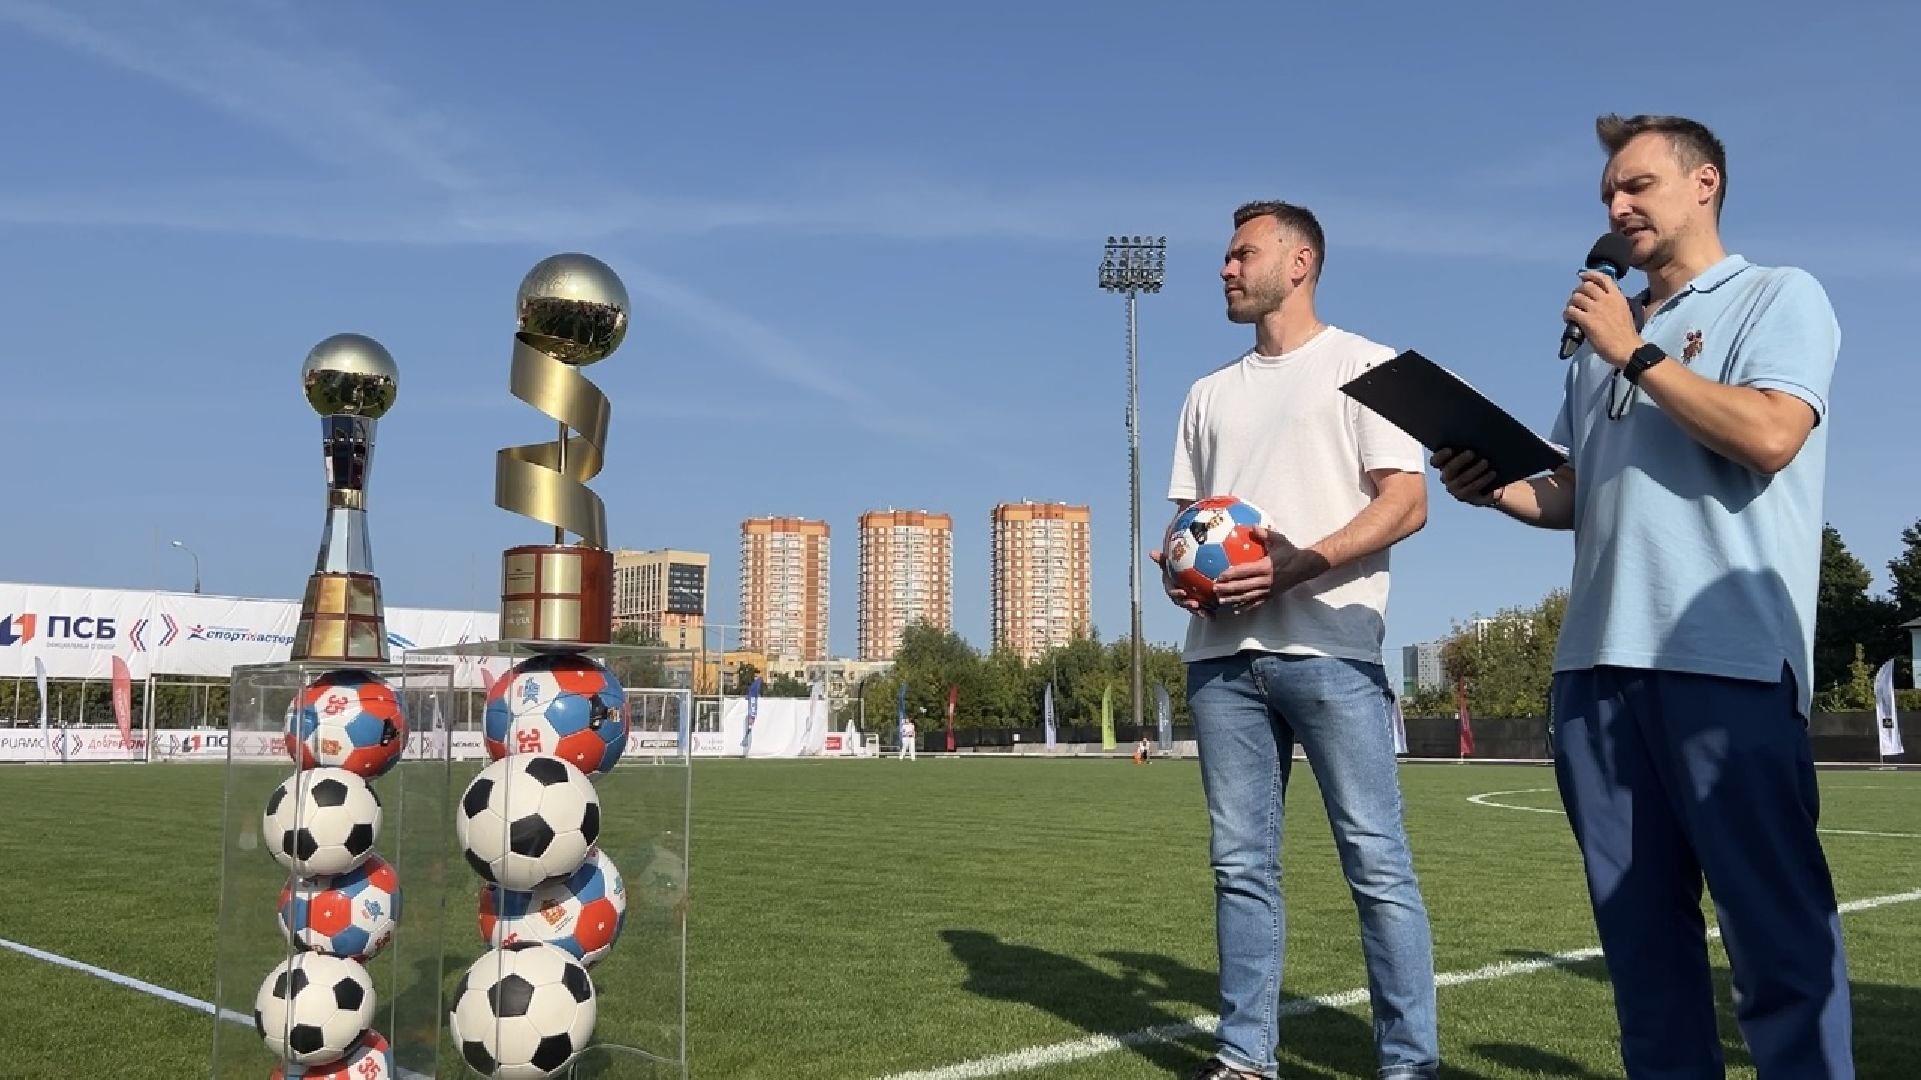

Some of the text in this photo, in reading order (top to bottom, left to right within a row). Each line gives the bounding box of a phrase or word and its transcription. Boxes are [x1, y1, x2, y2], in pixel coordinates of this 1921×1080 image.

[48, 616, 116, 639] ПСБ
[324, 695, 348, 715] 35
[206, 735, 229, 748] ПС
[517, 729, 541, 753] 35
[359, 1056, 381, 1080] 35
